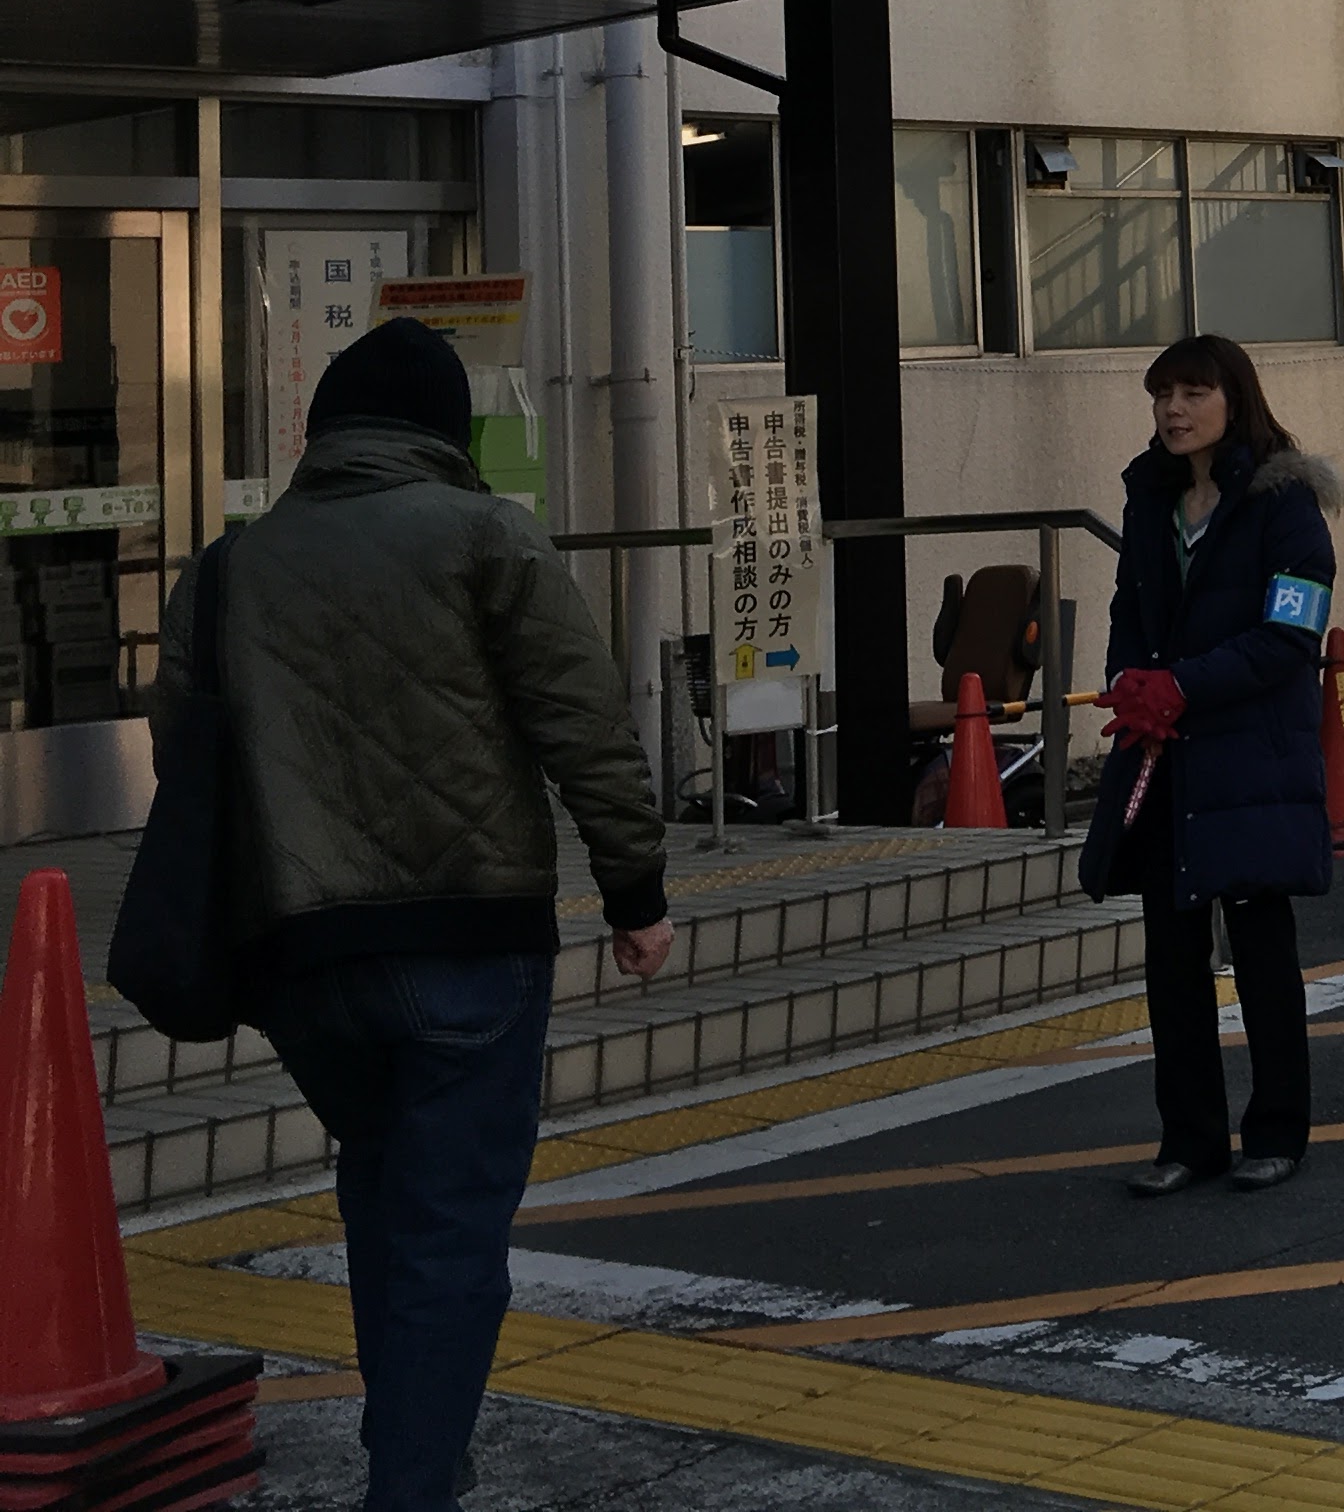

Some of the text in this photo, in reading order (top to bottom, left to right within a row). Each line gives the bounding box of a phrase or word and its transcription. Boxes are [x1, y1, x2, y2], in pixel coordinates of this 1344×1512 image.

[1, 272, 47, 289] AED
[102, 497, 157, 516] e-Tax
[728, 413, 759, 642] 申告書作成相談の方
[763, 411, 793, 638] 申告書提出のみの方
